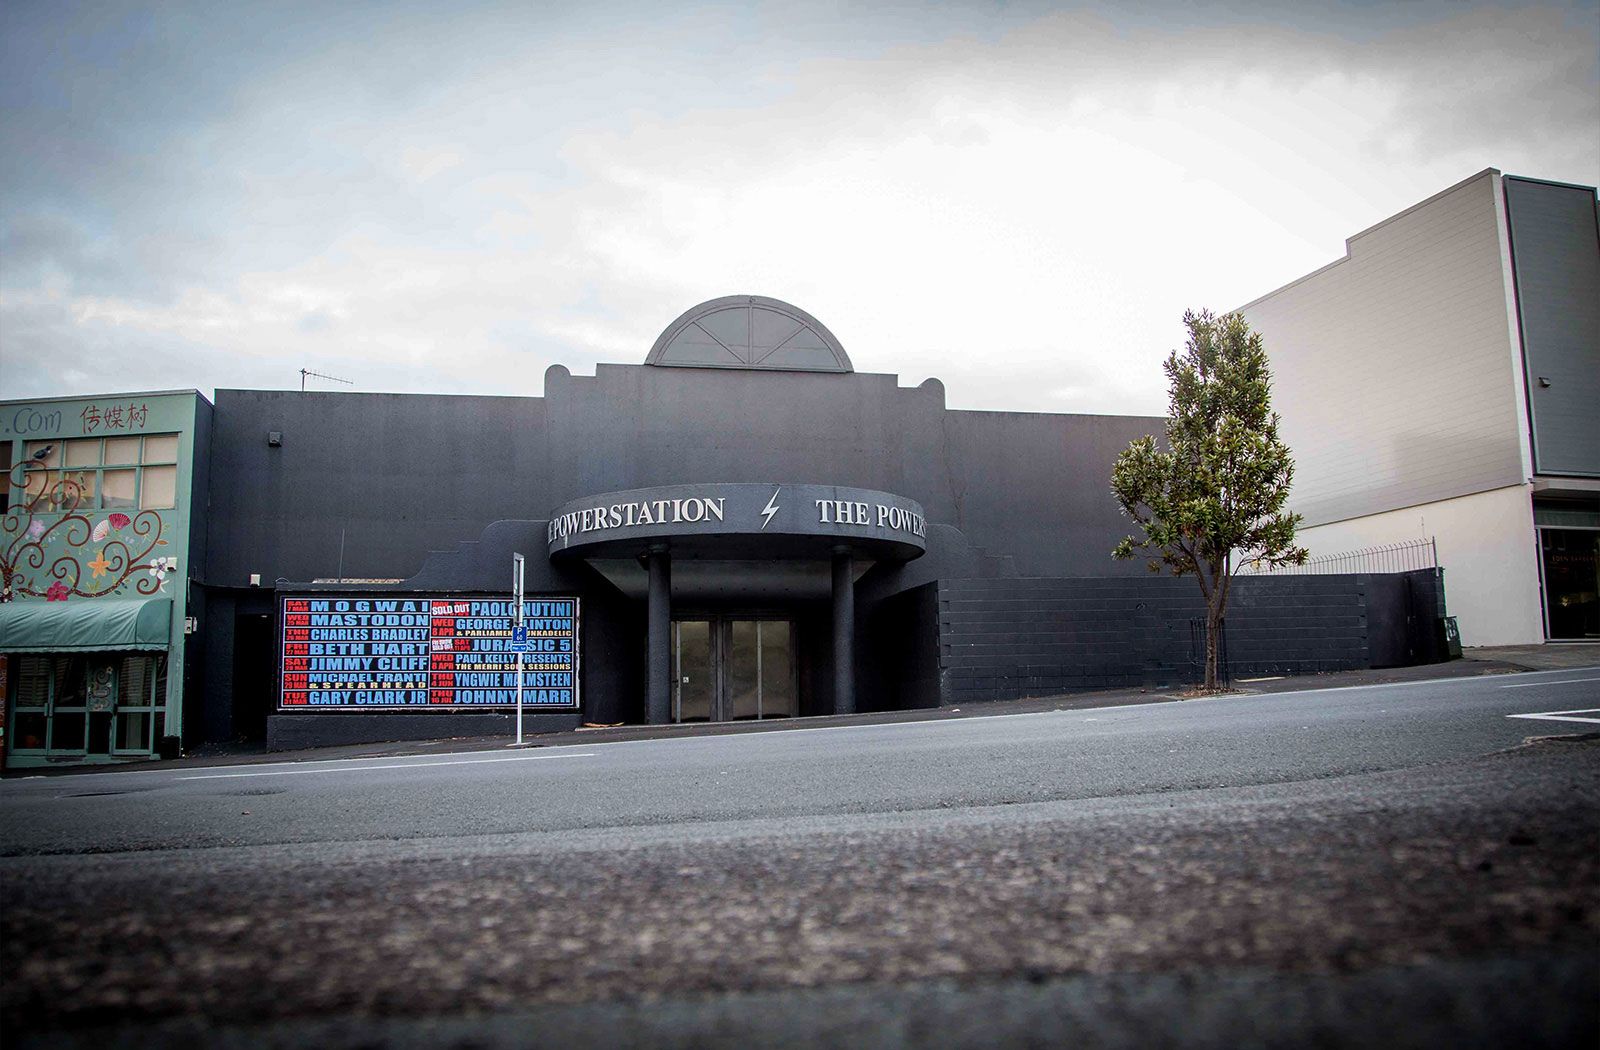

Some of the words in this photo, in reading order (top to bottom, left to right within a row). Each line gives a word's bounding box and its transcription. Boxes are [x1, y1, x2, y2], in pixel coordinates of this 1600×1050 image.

[0, 408, 62, 434] .Com
[80, 403, 148, 434] 传媒树
[554, 498, 725, 538] POWERSTATION
[816, 500, 870, 524] THE
[311, 601, 428, 611] MOGWAI
[432, 606, 452, 615] SOLD
[454, 604, 470, 613] OUT
[523, 603, 570, 616] NUTINI
[311, 615, 428, 626] MASTODON
[456, 619, 509, 630] GEORGE
[523, 620, 570, 630] LINTON
[311, 629, 368, 640] CHARLES
[372, 629, 428, 640] BRADLEY
[310, 644, 365, 655] BETH
[372, 644, 428, 655] HART
[472, 639, 556, 651] JURASIC
[560, 640, 570, 651] 5
[310, 658, 372, 670] JIMMY
[378, 658, 428, 670] CLIFF
[456, 655, 482, 663] PAUL
[486, 655, 515, 663] KELLY
[309, 674, 373, 682] MICHAEL
[377, 673, 426, 682] FRANTI
[455, 674, 500, 686] YNGWIE
[309, 692, 351, 704] GARY
[356, 692, 406, 704] CLARK
[410, 692, 426, 704] JR
[454, 691, 518, 703] JOHNNY
[524, 691, 570, 703] MARR
